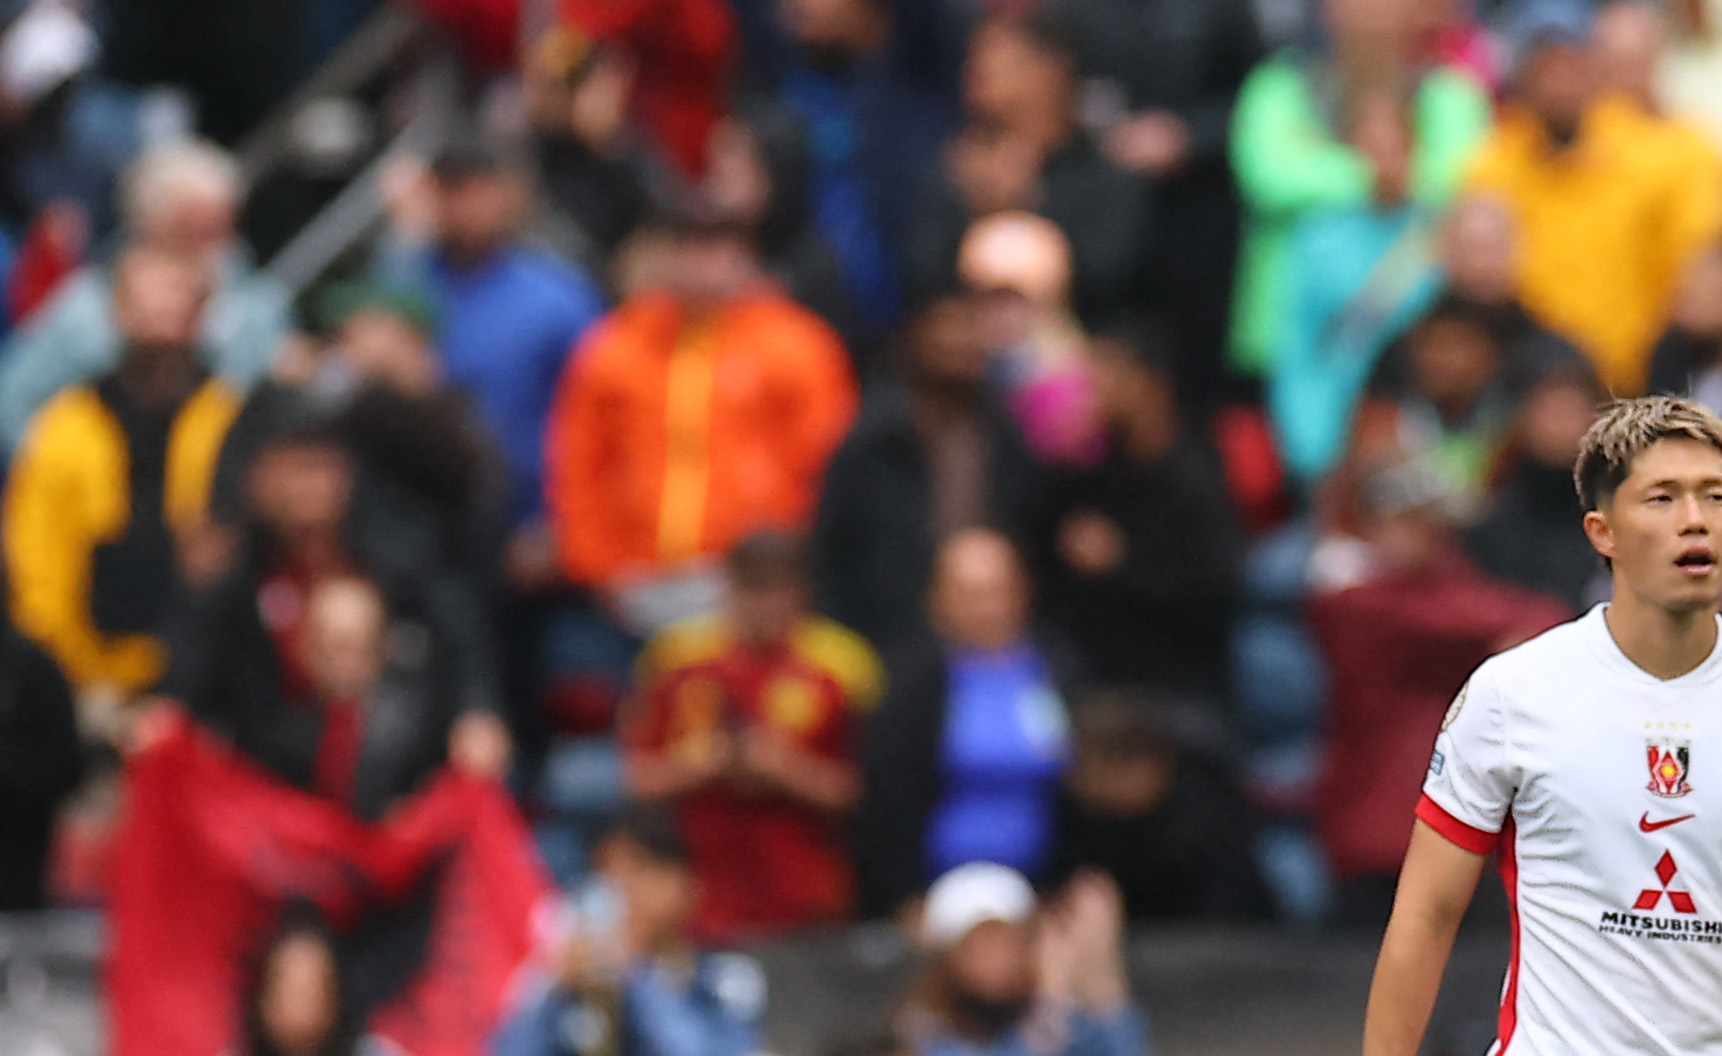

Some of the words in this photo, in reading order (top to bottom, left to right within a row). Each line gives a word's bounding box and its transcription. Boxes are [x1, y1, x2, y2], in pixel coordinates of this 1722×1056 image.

[1600, 911, 1722, 934] MITSUBISHI
[1599, 924, 1642, 938] HEAVY
[1647, 931, 1722, 944] INDUSTRIES
